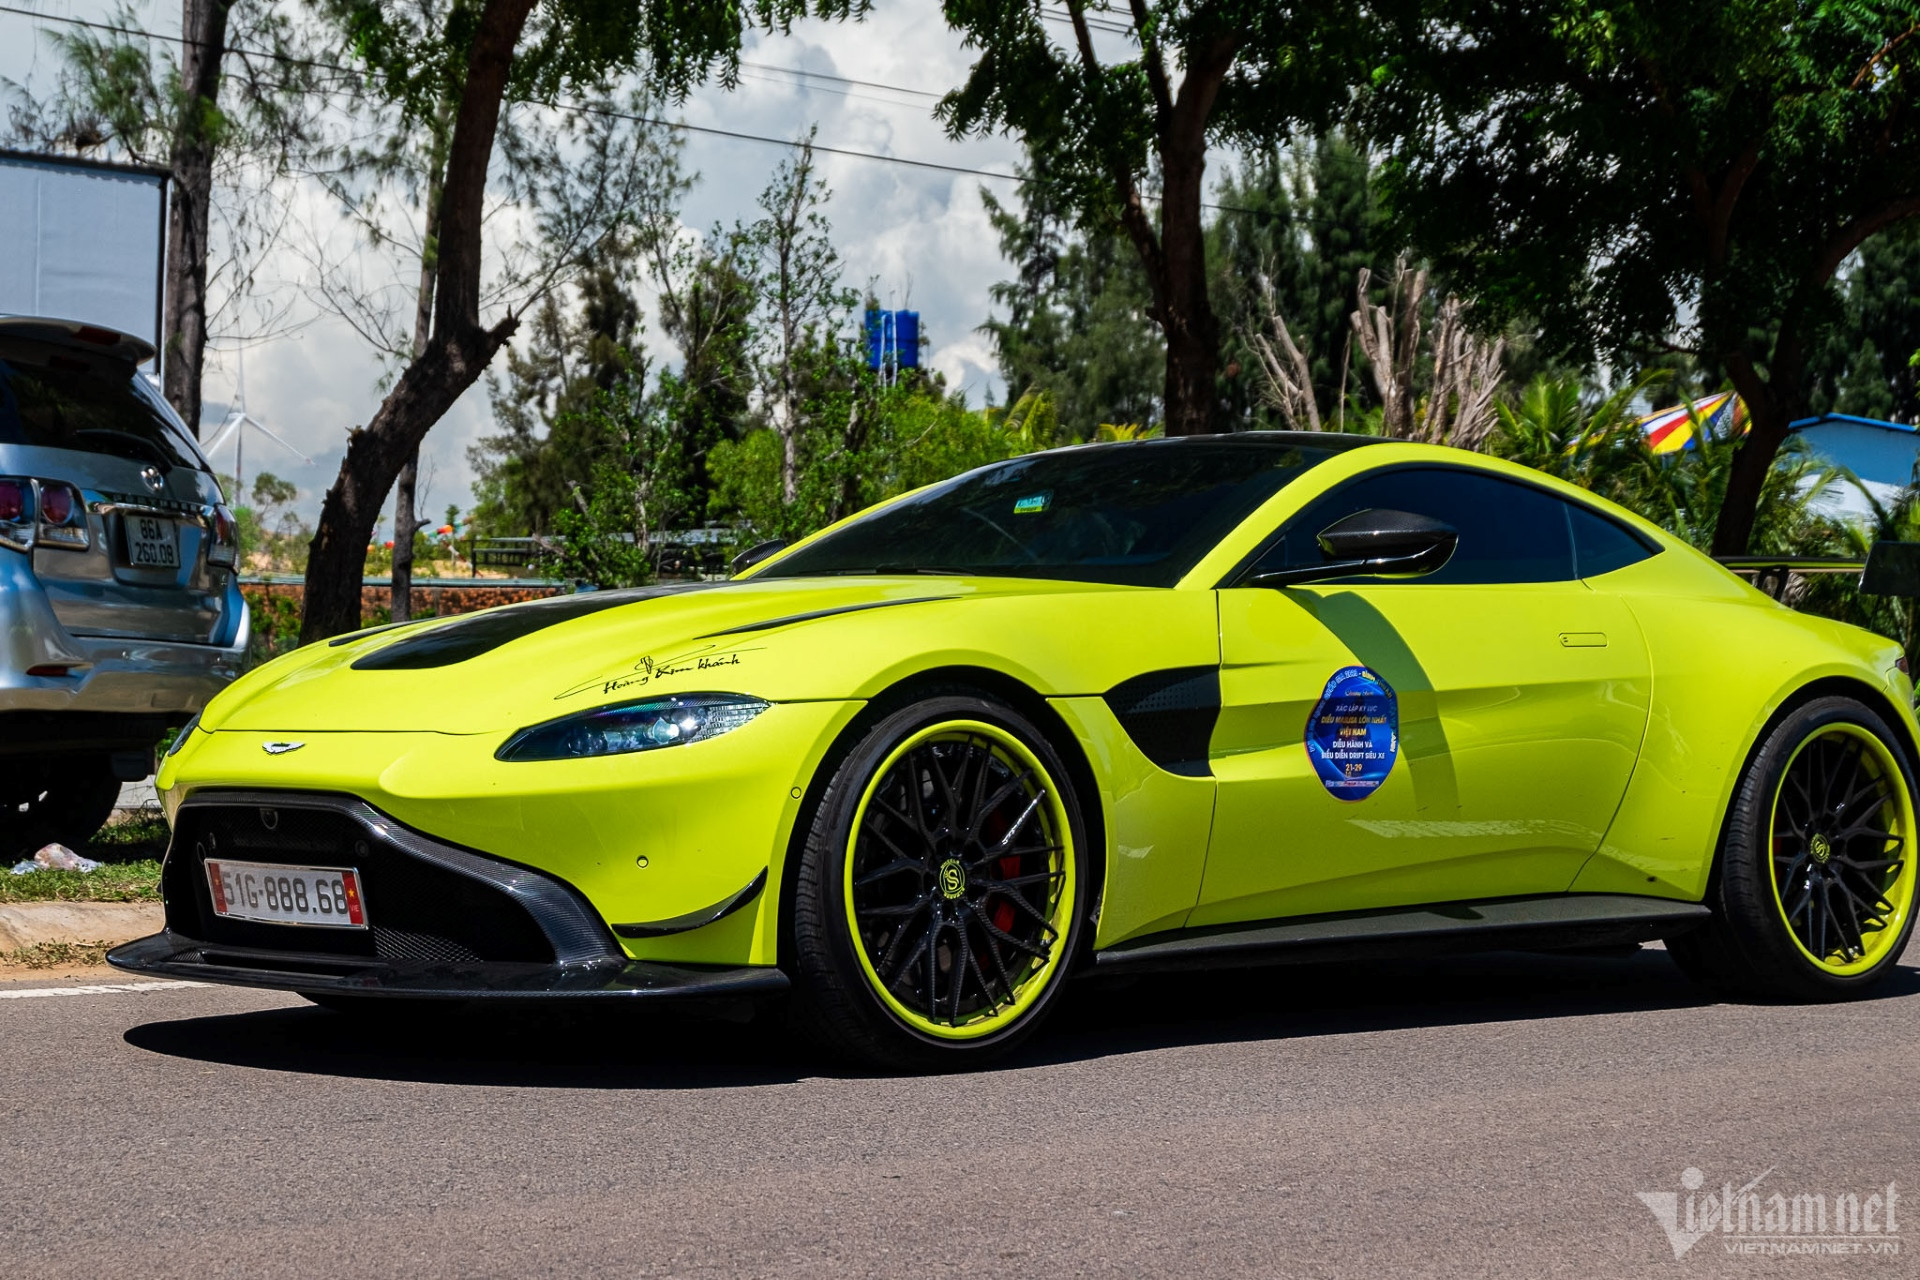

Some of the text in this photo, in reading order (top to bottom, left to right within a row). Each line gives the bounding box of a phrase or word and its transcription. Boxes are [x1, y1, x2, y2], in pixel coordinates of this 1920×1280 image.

[140, 519, 163, 540] 86A
[1352, 728, 1367, 736] NAM
[222, 871, 348, 915] 51G-888.68
